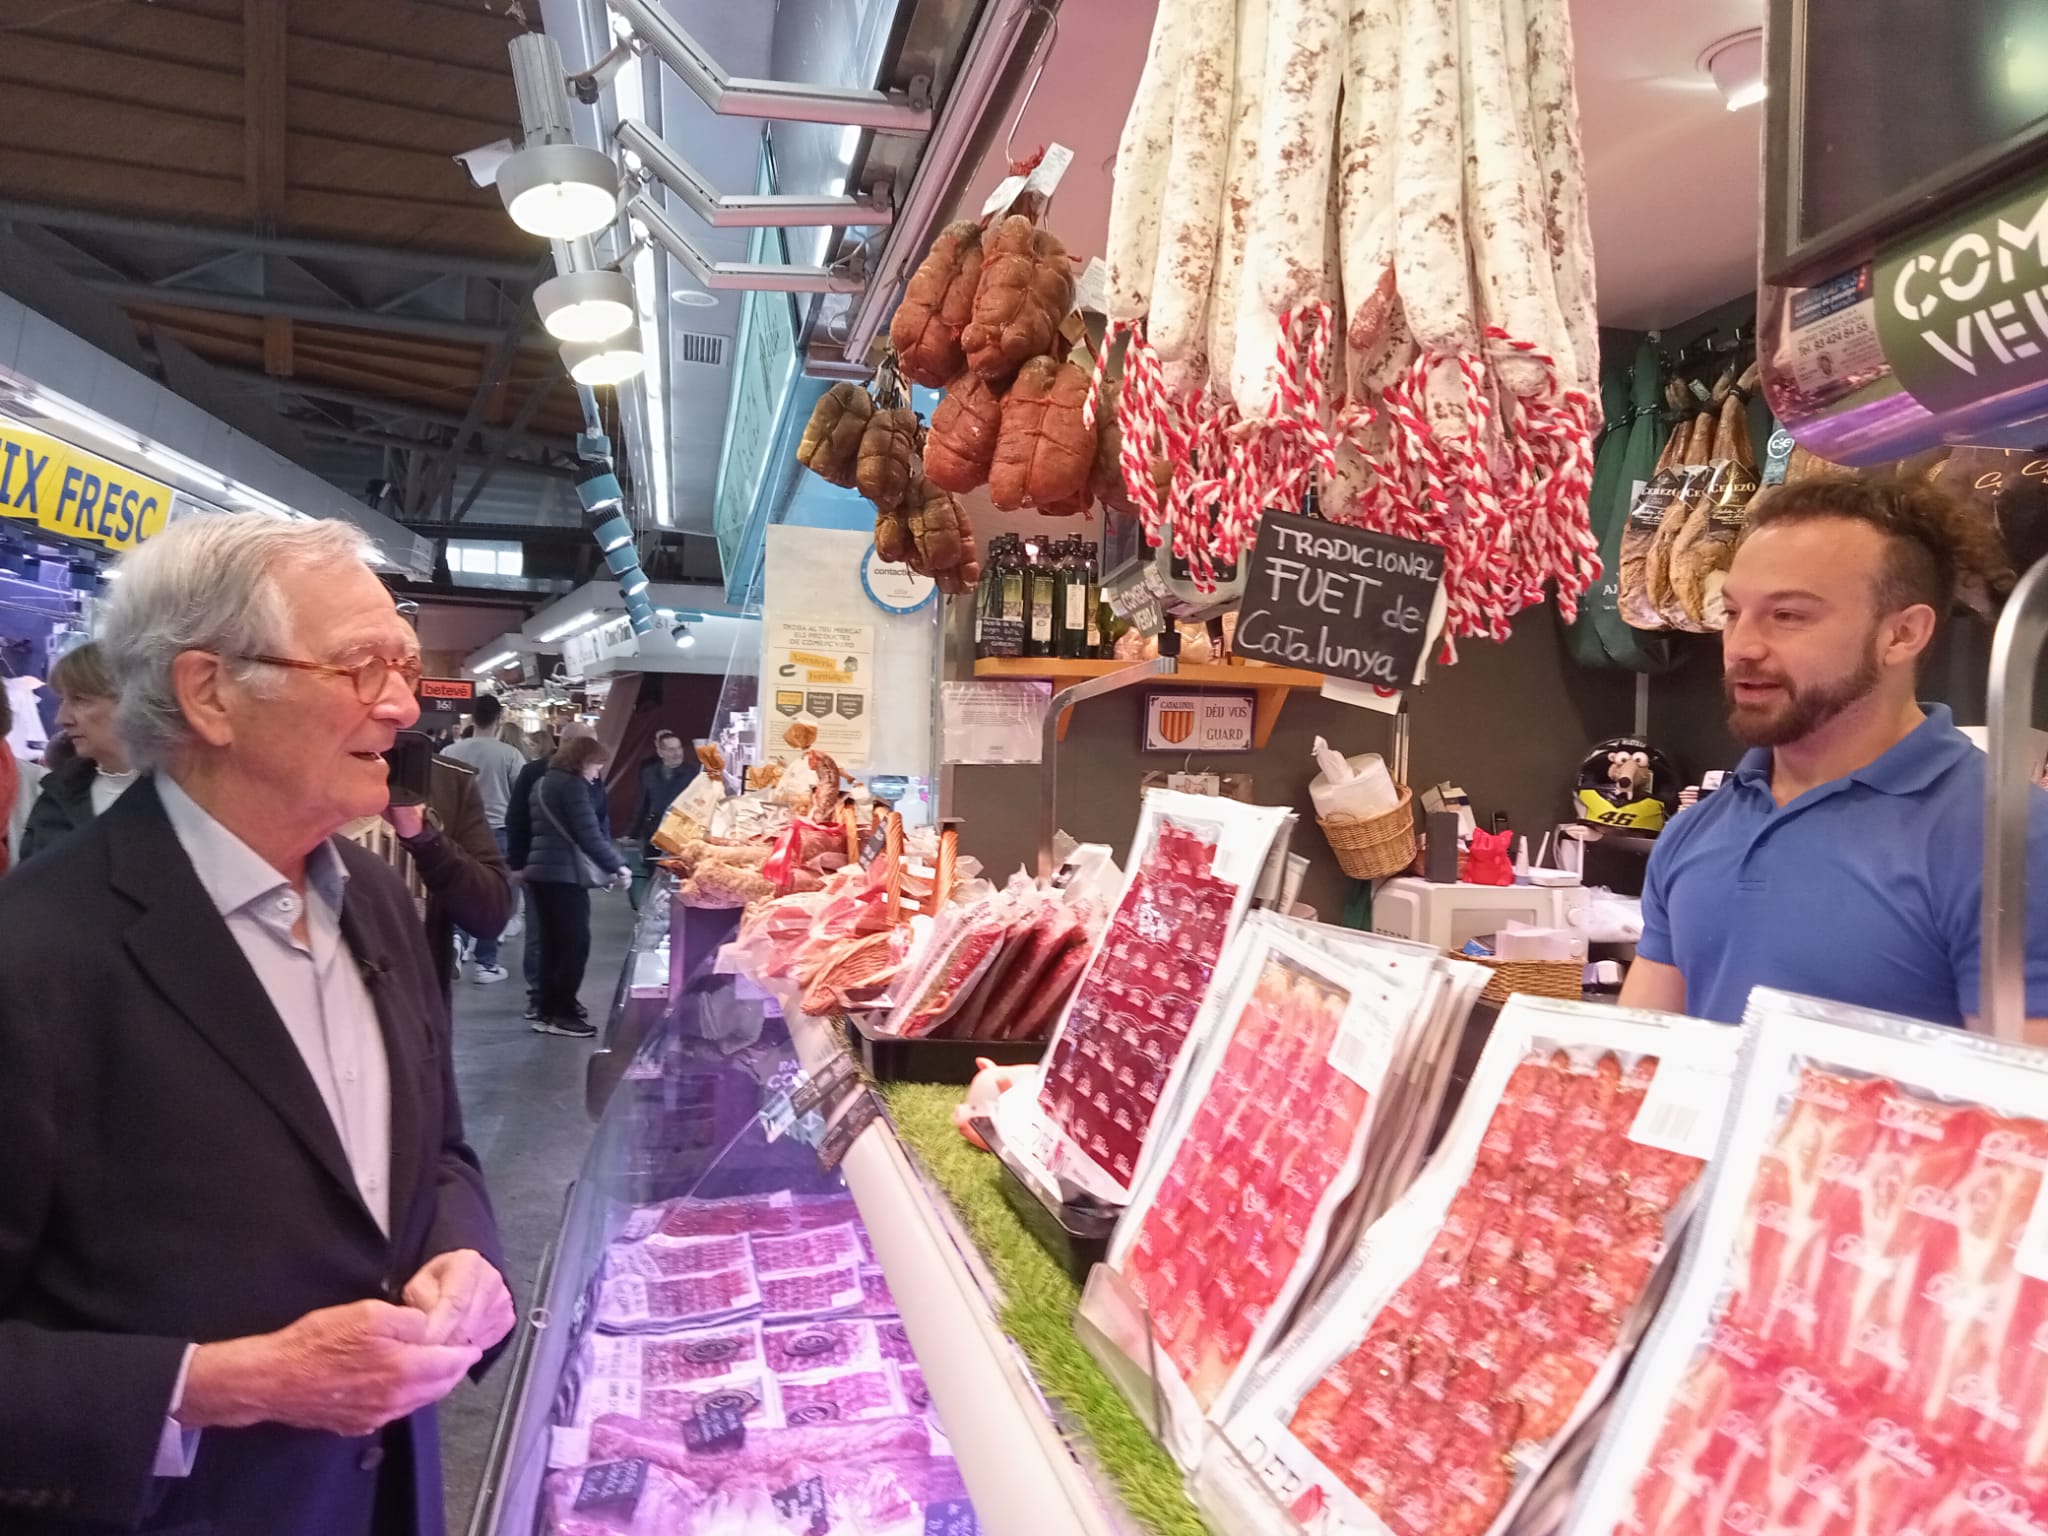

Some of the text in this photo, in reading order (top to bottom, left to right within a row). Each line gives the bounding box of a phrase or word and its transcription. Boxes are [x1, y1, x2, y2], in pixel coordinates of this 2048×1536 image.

[0, 438, 158, 544] IX FRESC
[1271, 524, 1438, 582] TRADICIONAL
[1265, 557, 1424, 633] FUET de
[425, 684, 468, 697] betevé
[1229, 706, 1247, 717] VOS
[1206, 728, 1243, 740] GUARD
[1597, 811, 1638, 826] 46
